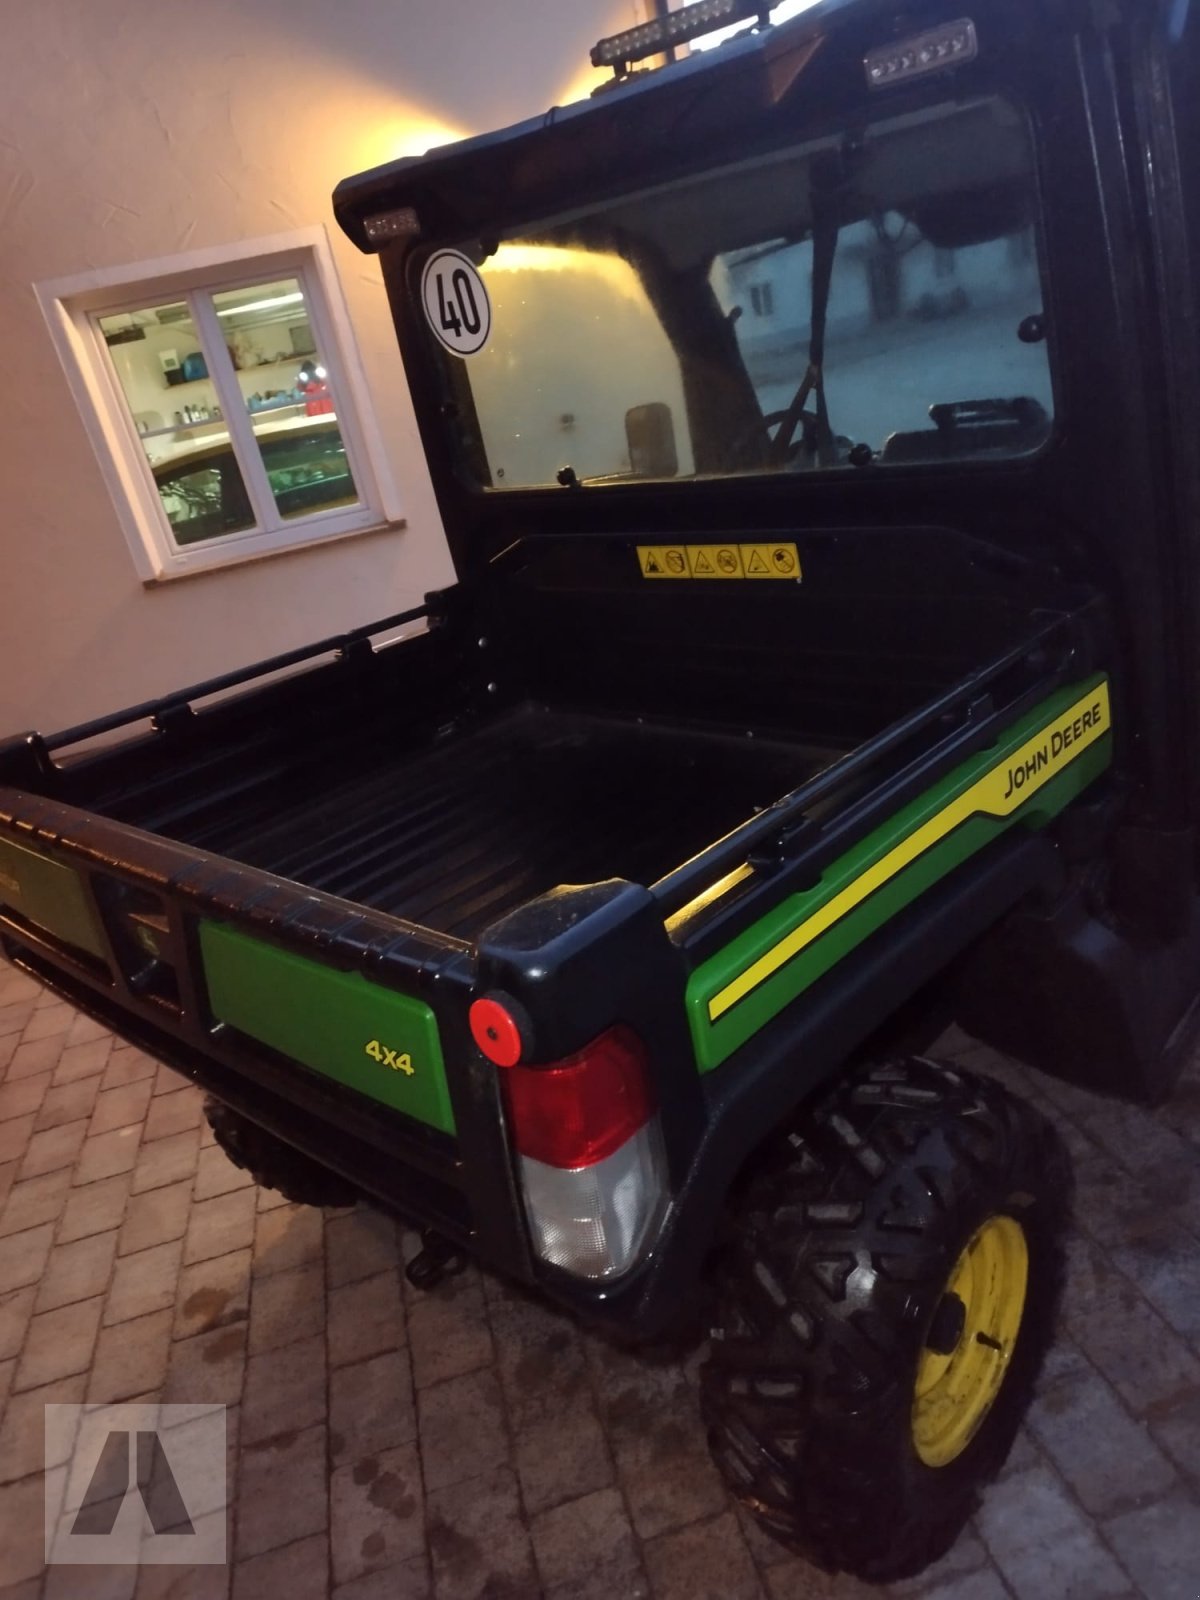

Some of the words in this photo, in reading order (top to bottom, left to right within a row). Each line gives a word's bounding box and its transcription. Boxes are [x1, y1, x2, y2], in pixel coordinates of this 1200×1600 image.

[436, 268, 481, 338] 40
[1004, 745, 1048, 800] JOHN
[1050, 702, 1101, 759] DEERE
